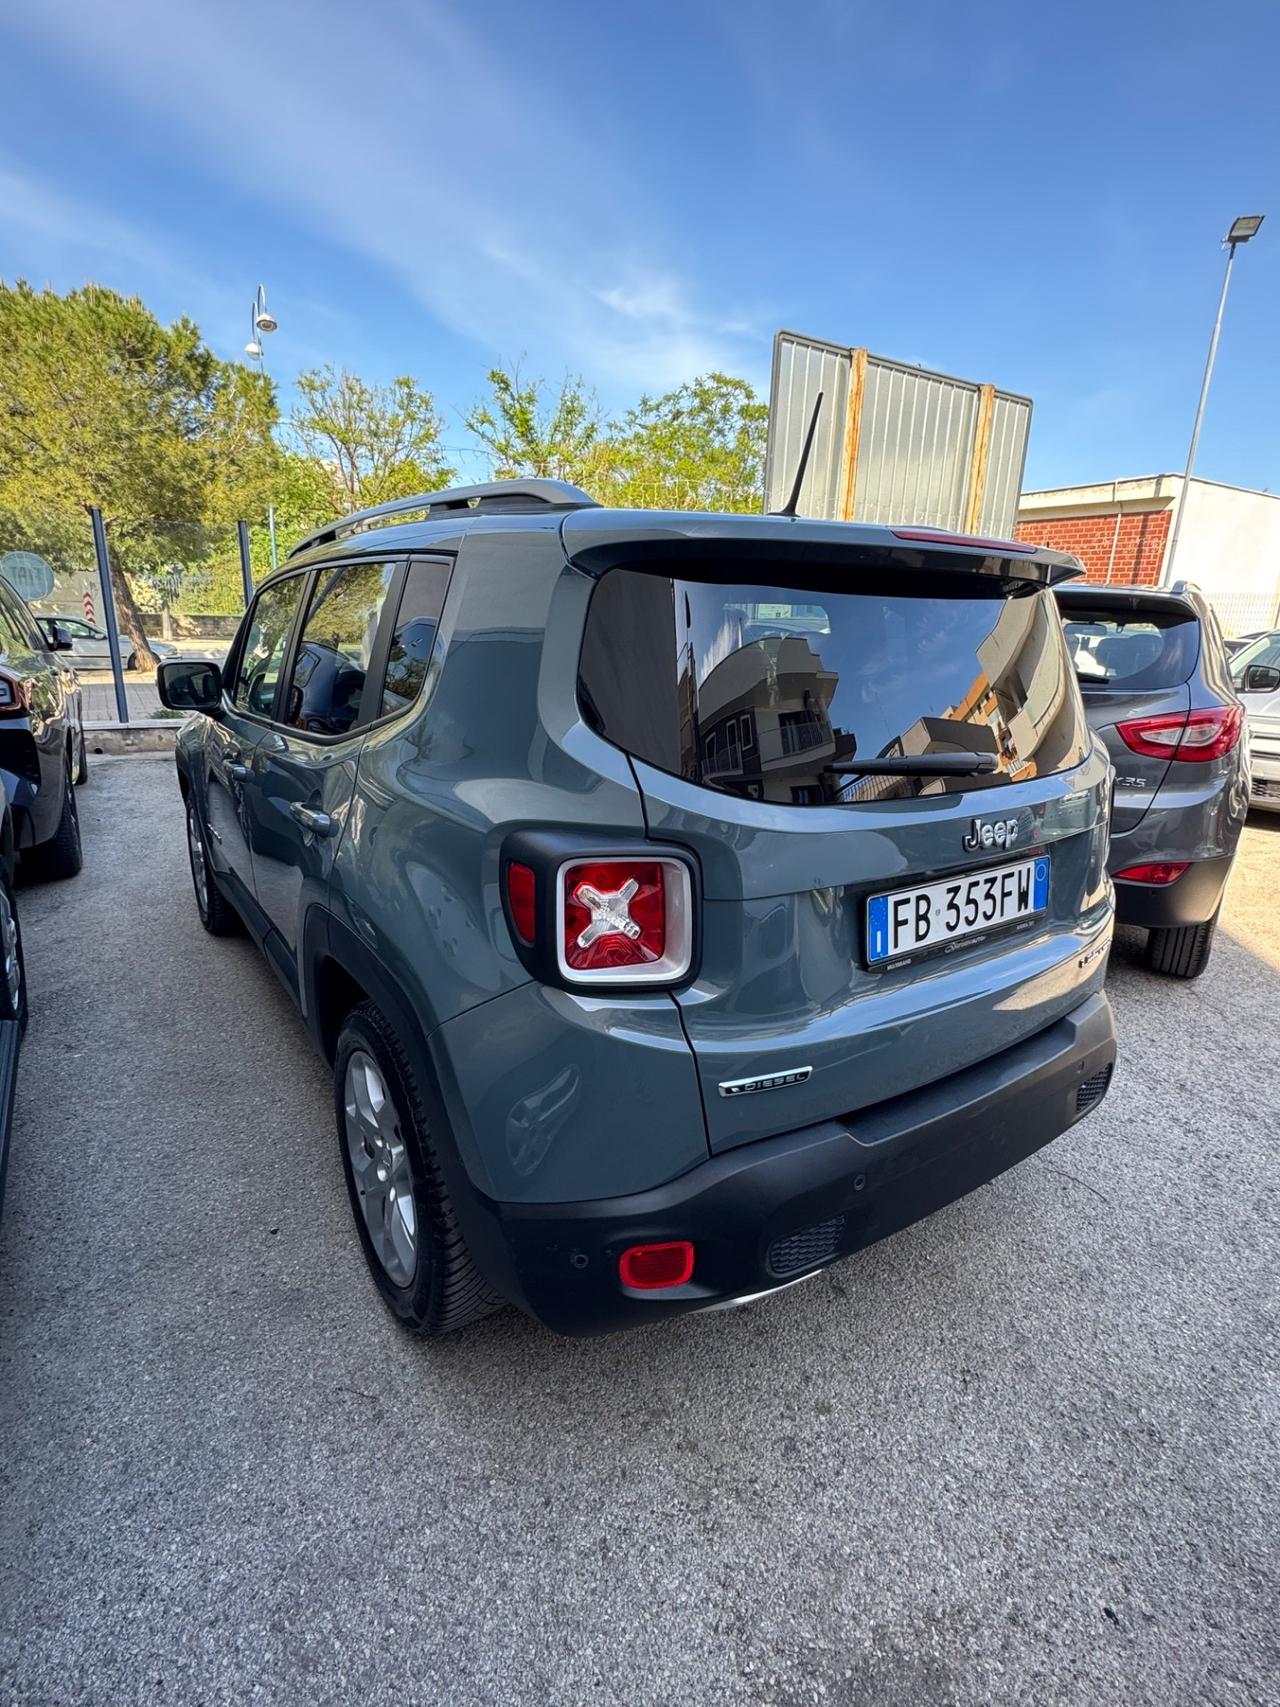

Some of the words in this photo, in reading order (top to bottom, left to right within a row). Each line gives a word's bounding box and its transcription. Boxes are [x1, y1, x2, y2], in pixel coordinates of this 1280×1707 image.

[964, 818, 1018, 852] Jeep
[892, 893, 931, 949] FB
[945, 867, 1031, 932] 353FW
[744, 1072, 806, 1092] DIESEL
